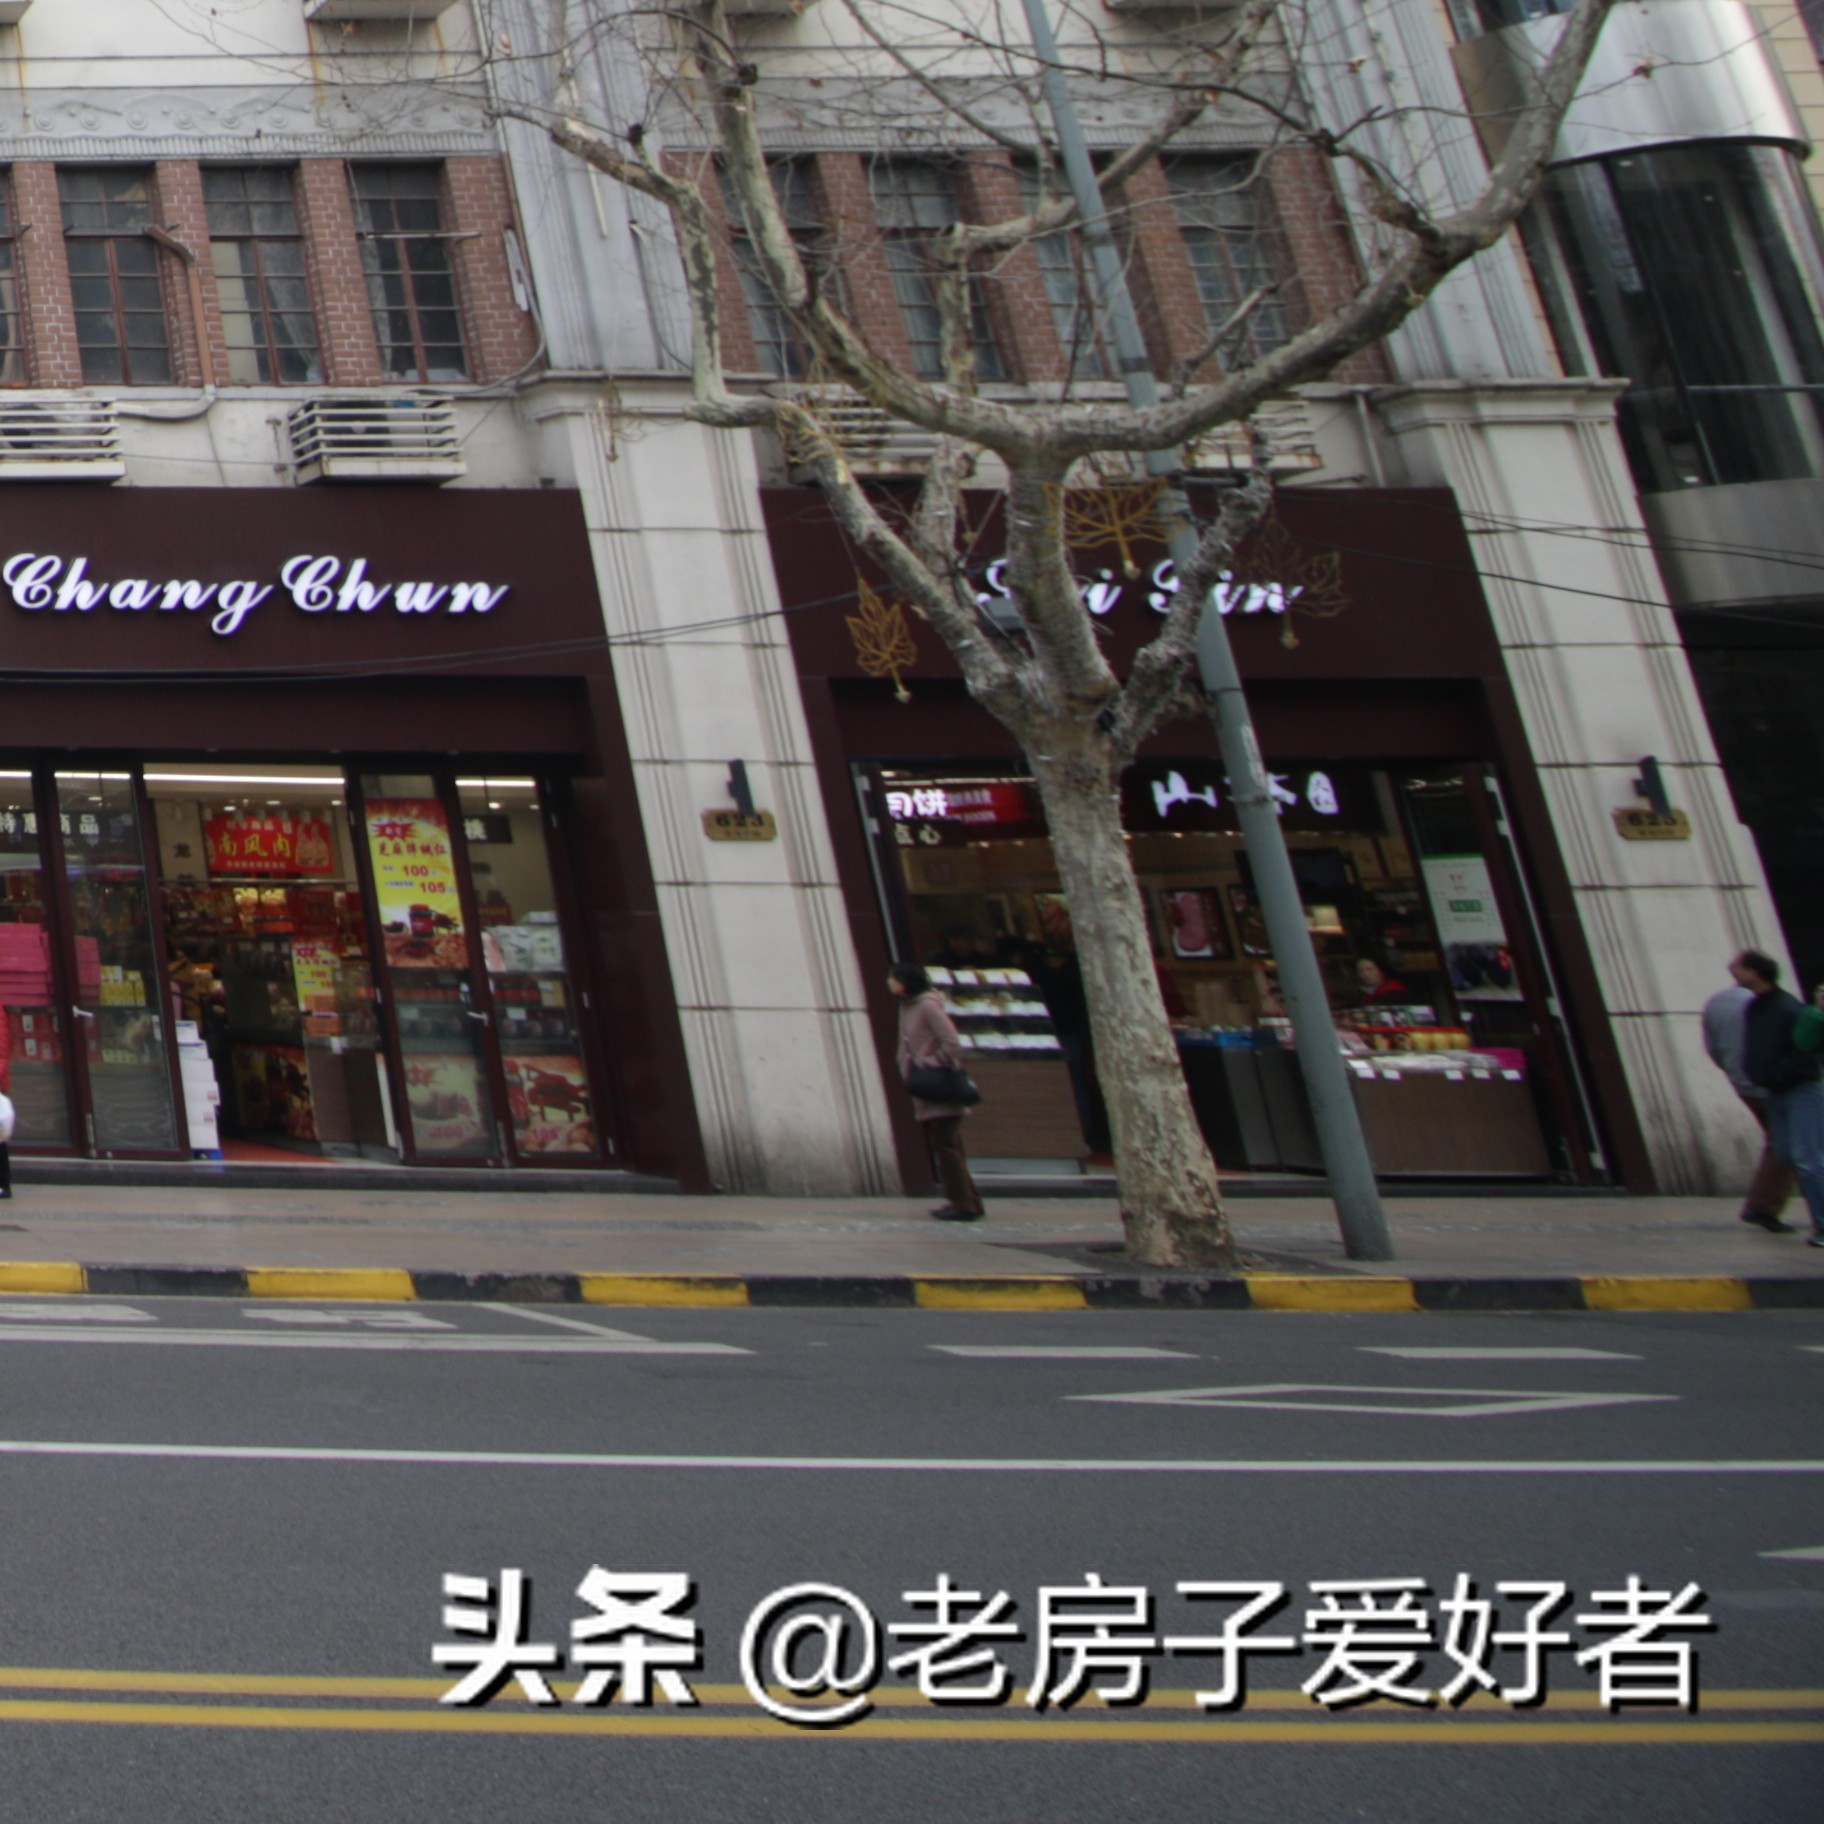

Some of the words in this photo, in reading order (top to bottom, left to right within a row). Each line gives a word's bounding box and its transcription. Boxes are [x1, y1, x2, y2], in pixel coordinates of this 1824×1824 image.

[2, 553, 274, 635] Chang
[281, 554, 510, 613] Chun
[404, 865, 429, 876] 100
[420, 881, 446, 893] 105
